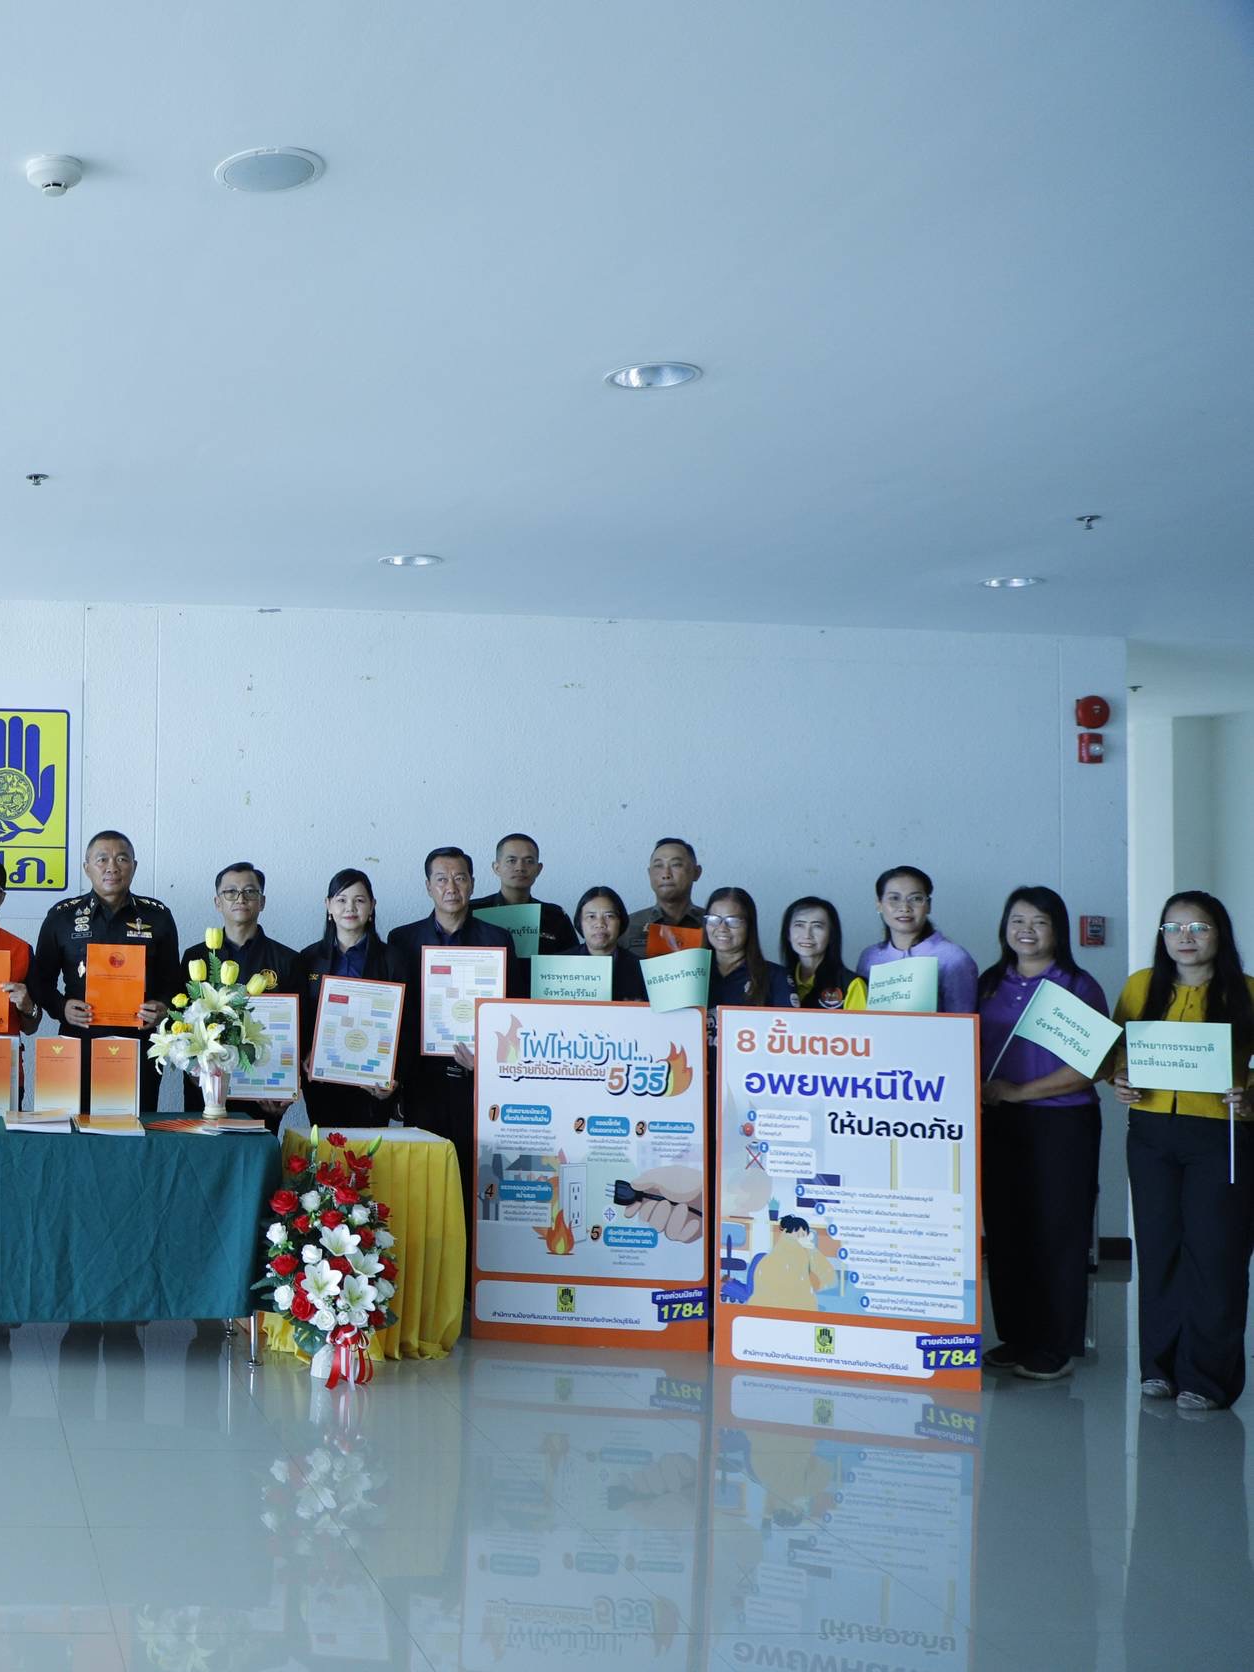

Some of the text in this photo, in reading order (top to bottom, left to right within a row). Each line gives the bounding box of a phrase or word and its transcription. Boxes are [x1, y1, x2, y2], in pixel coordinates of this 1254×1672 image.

[540, 973, 601, 983] พระพุทธศาสนา
[544, 987, 597, 1000] จังหวัดบุรีรัมย์
[1051, 1006, 1091, 1039] วัฒนธรรม
[737, 1019, 870, 1057] 8 ขั้นตอน
[1035, 1018, 1091, 1058] จังหวัดบุรีรัมย์
[1129, 1040, 1215, 1052] ทรัพยากรธรรมชาติ
[1130, 1055, 1198, 1069] และสิ่งแวดล้อม
[499, 1060, 666, 1092] เหตุร้ายที่ป้องกันได้ด้วย 5 วิธี
[745, 1069, 945, 1102] อพยพหนีไฟ
[491, 1106, 498, 1121] 1
[575, 1118, 585, 1133] 2
[636, 1121, 645, 1136] 3
[828, 1111, 963, 1141] ให้ปลอดภัย
[485, 1183, 494, 1198] 4
[590, 1226, 600, 1240] 5
[655, 1289, 703, 1301] สายด่วนนิรภัย
[661, 1301, 705, 1320] 1784
[921, 1335, 975, 1346] สายด่วนนิรภัย
[927, 1348, 977, 1366] 1784
